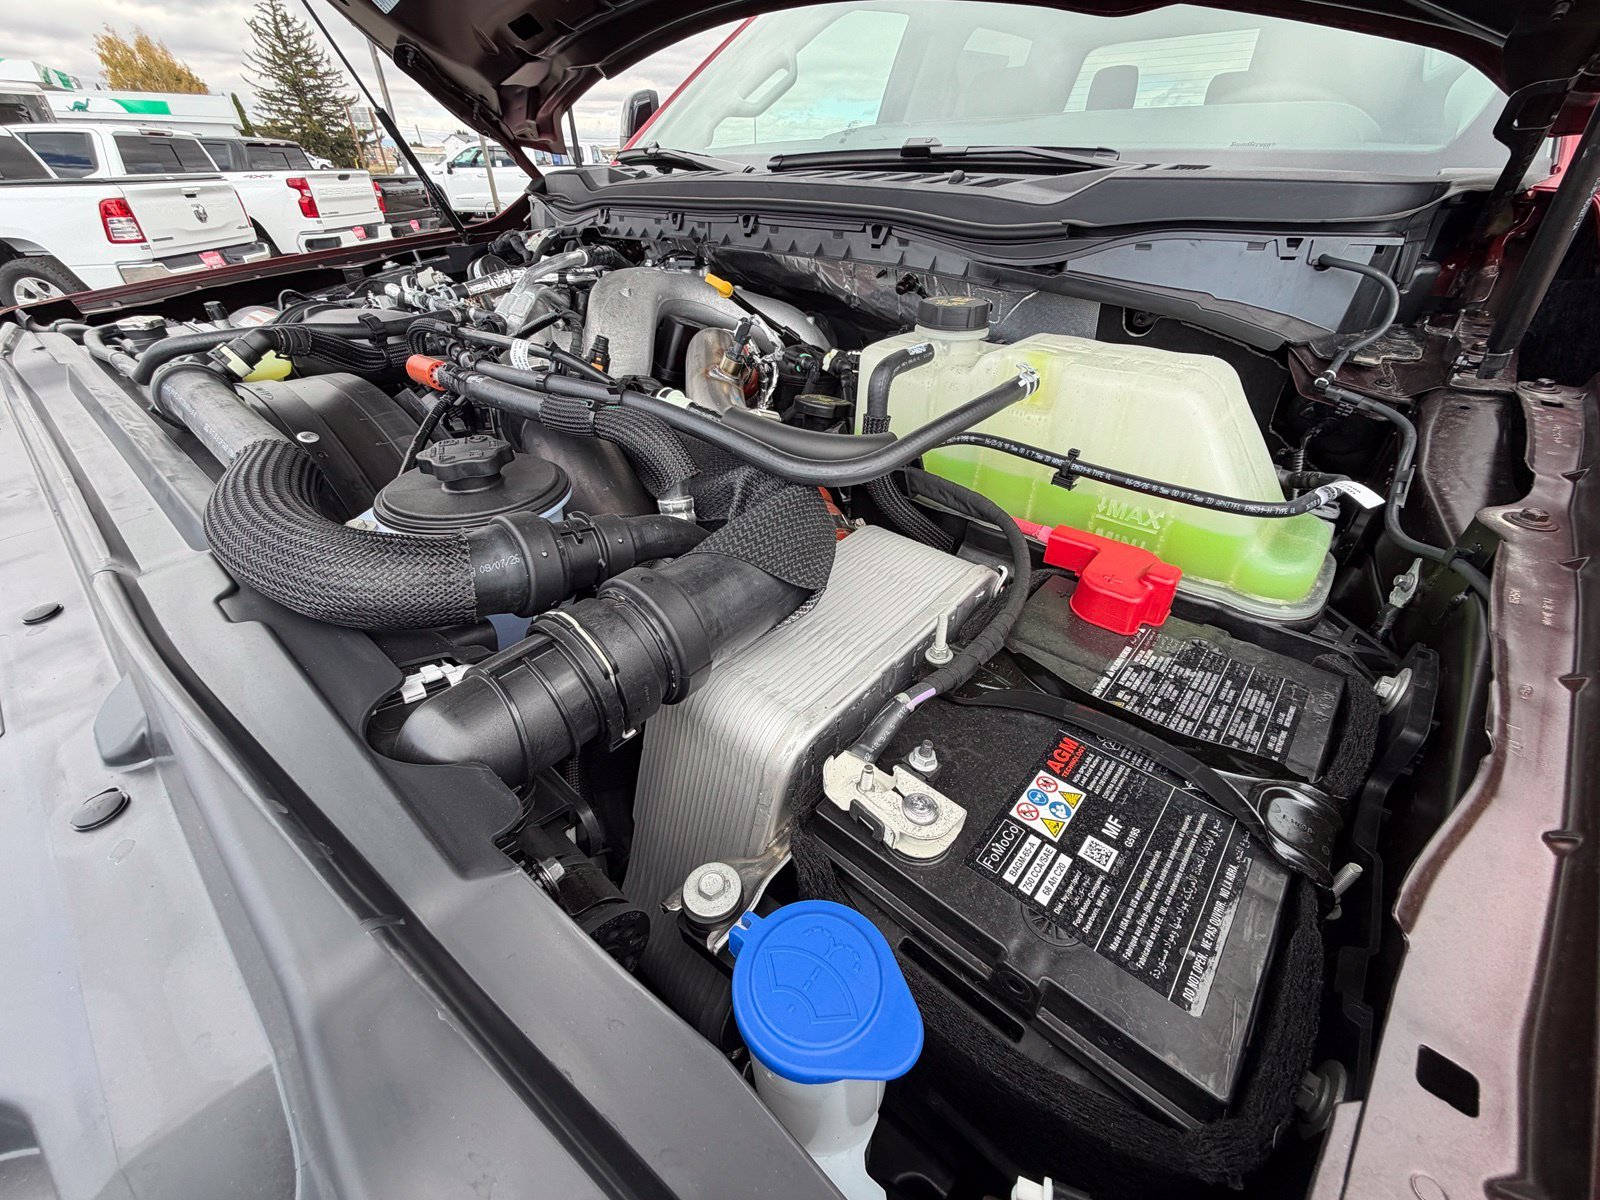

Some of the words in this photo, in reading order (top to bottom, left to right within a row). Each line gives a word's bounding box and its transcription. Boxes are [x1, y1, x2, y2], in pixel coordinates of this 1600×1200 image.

[1106, 499, 1165, 530] MAX
[1045, 735, 1080, 774] AGM
[1061, 744, 1087, 778] TECHNOLOGY
[1100, 814, 1126, 840] MF
[981, 822, 1020, 870] FoMoCo
[1123, 826, 1142, 849] G519S
[1008, 840, 1037, 878] BAGM-65-A
[1022, 876, 1036, 891] 750
[1030, 846, 1054, 879] CCA/SAE
[1053, 861, 1067, 878] C20
[1225, 862, 1240, 882] ABRA.
[1042, 885, 1053, 896] 68
[1047, 875, 1059, 888] Ah
[1098, 884, 1113, 901] 48121
[1219, 888, 1231, 899] NO
[1072, 913, 1085, 928] Ford
[1079, 897, 1094, 915] Motor
[1124, 906, 1135, 920] with
[1129, 899, 1139, 909] US
[1119, 917, 1130, 931] USA
[1204, 924, 1218, 941] PAS
[1109, 934, 1122, 952] Made
[1200, 937, 1213, 951] NE
[1192, 951, 1208, 974] OPEN.
[1186, 970, 1201, 990] NOT
[1182, 987, 1196, 1002] DO
